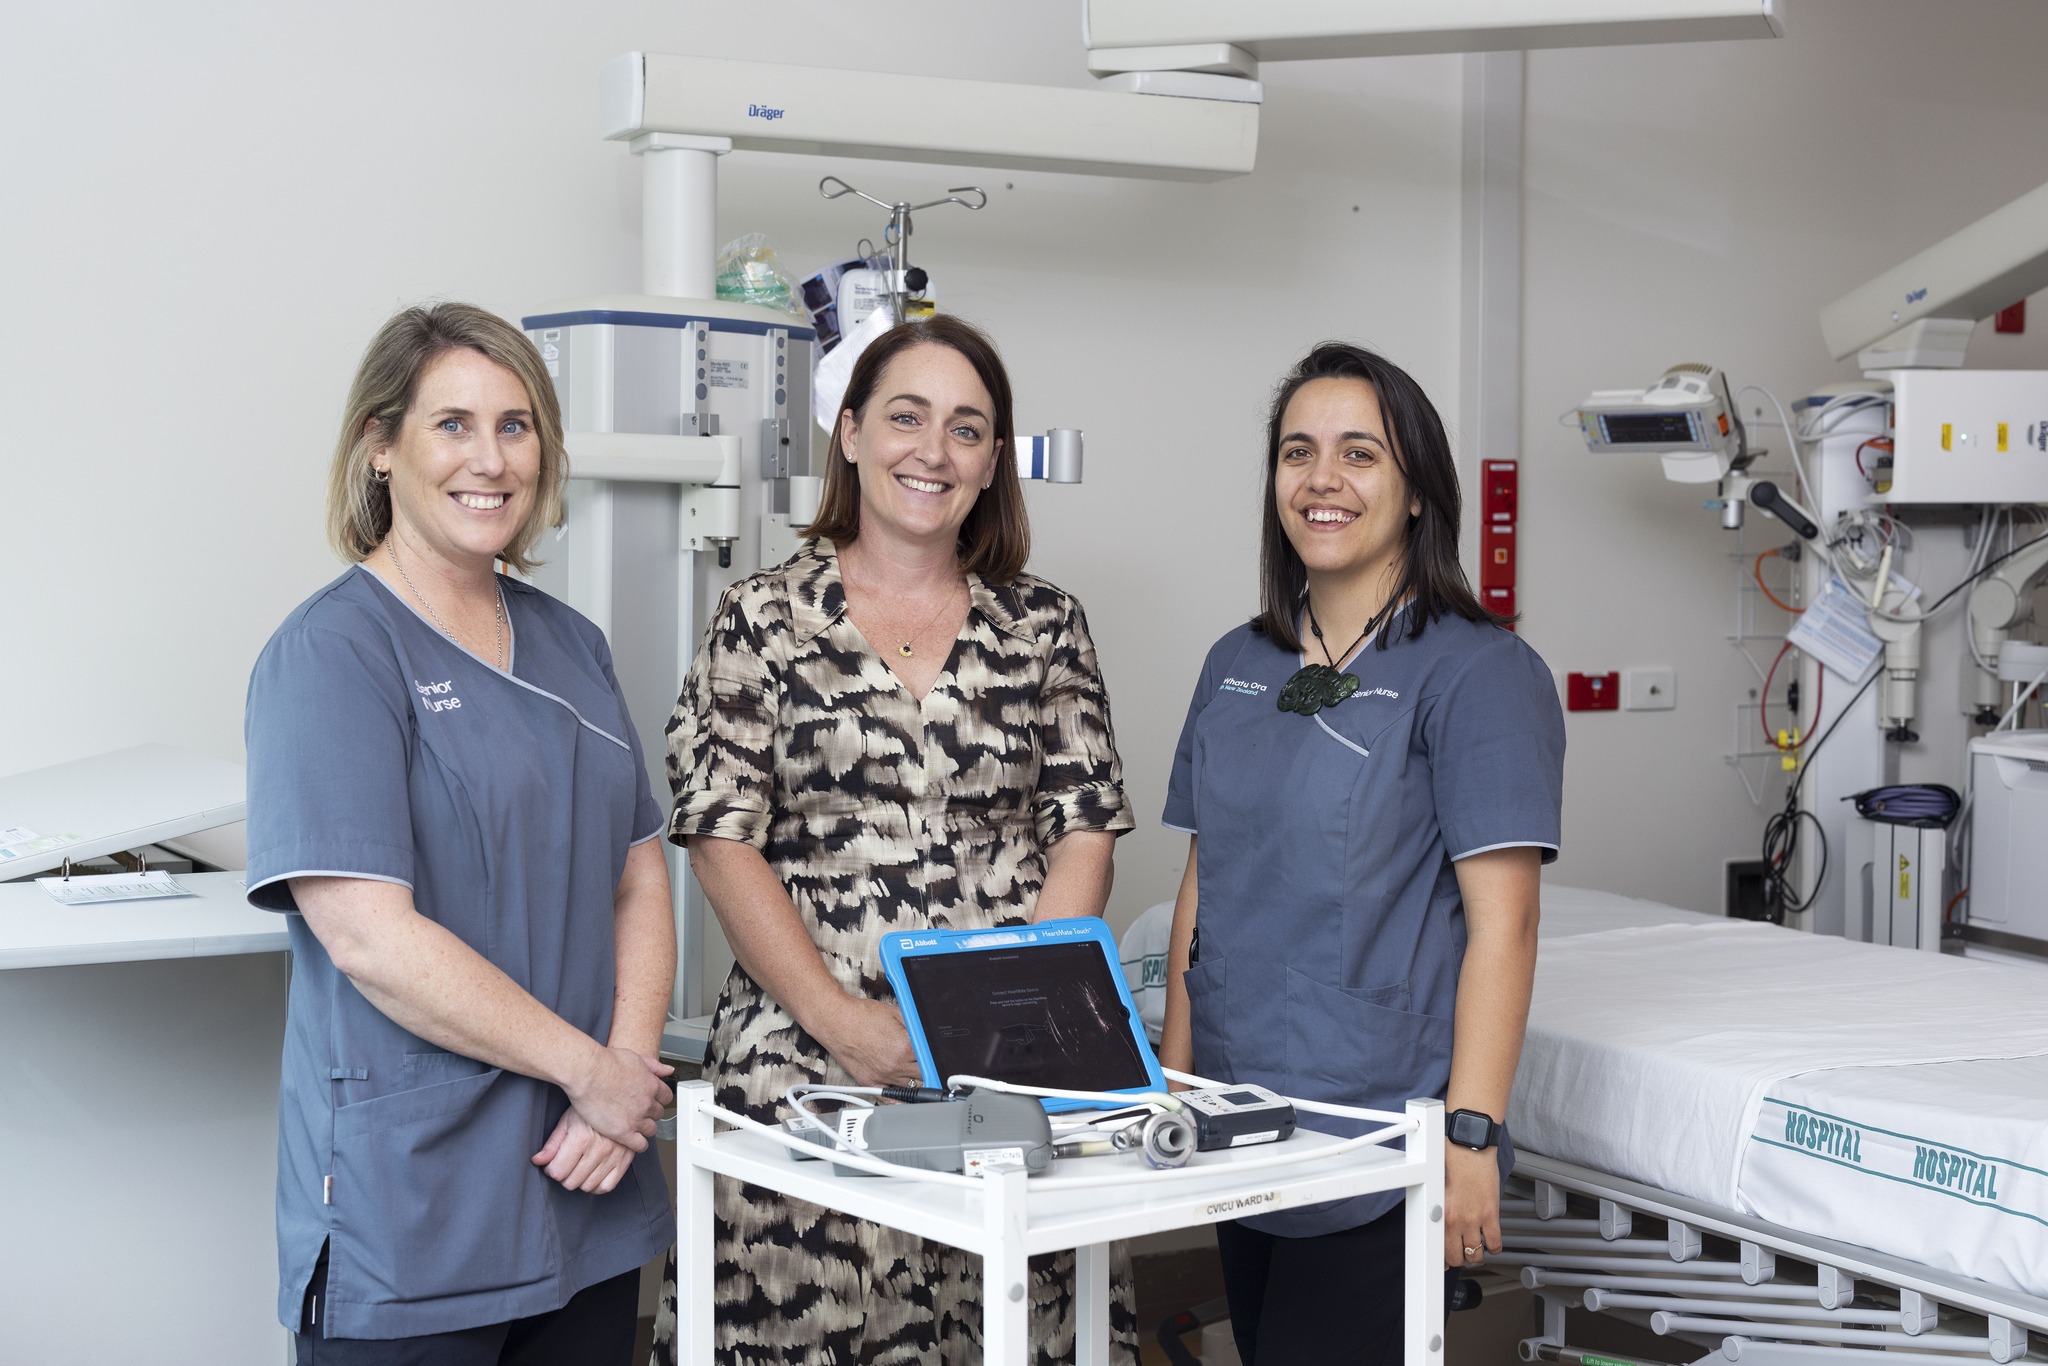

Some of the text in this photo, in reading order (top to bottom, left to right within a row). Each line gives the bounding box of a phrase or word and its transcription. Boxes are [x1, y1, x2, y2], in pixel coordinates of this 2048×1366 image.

[748, 104, 785, 120] Dräger
[1223, 677, 1249, 689] Whatu
[1250, 682, 1267, 692] Ora
[1373, 687, 1399, 699] Nurse
[422, 696, 461, 712] Nurse
[1041, 929, 1073, 938] HeartMate
[914, 939, 938, 947] Abbott
[1785, 1110, 1861, 1163] HOSPITAL
[1002, 1151, 1021, 1159] CNS
[1912, 1145, 1998, 1200] HOSPITAL
[1206, 1200, 1234, 1215] CVICU
[1235, 1194, 1263, 1209] WARD
